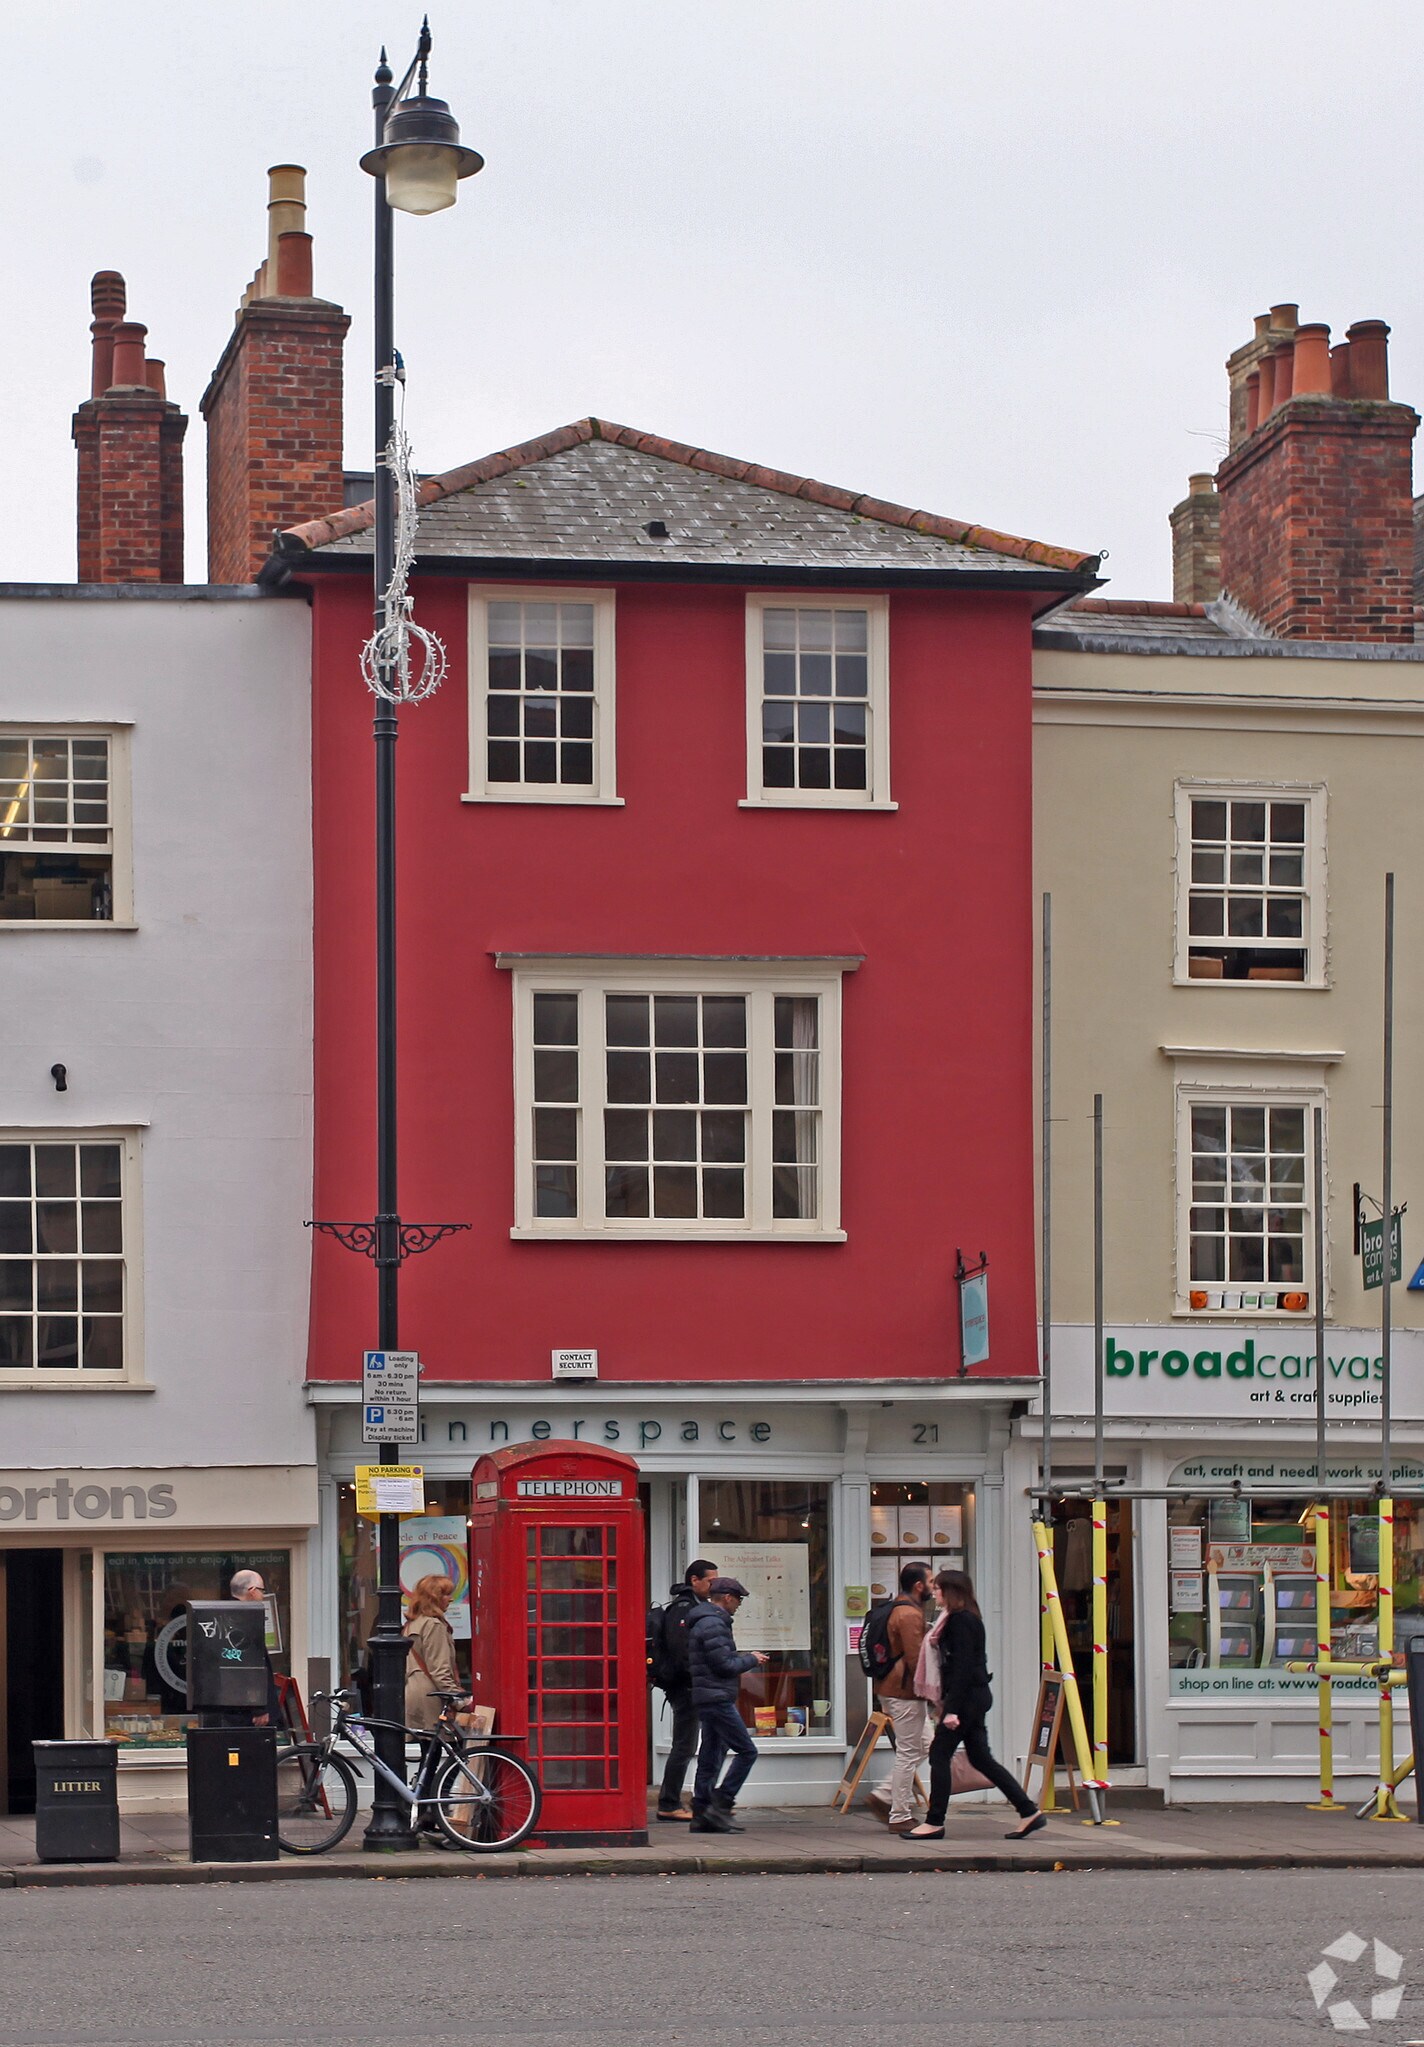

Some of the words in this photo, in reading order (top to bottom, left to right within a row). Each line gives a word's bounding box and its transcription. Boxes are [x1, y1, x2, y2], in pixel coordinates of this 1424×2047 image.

[1363, 1222, 1397, 1253] brod
[1364, 1246, 1398, 1268] cans
[1366, 1272, 1375, 1284] art
[1375, 1269, 1380, 1281] &
[388, 1355, 414, 1363] Loading
[559, 1353, 593, 1361] CONTACT
[558, 1361, 593, 1369] SECURITY
[1249, 1390, 1270, 1403] art
[1274, 1390, 1285, 1403] &
[1290, 1389, 1317, 1403] craf
[421, 1414, 772, 1448] innerspace
[912, 1423, 939, 1444] 21
[1184, 1464, 1206, 1478] art,
[1211, 1464, 1244, 1477] craft
[1247, 1464, 1274, 1477] and
[1280, 1464, 1362, 1478] needlwork
[1367, 1464, 1424, 1481] suplies
[520, 1481, 618, 1495] TELEPHONE
[400, 1532, 414, 1541] cle
[418, 1532, 428, 1541] of
[433, 1532, 458, 1540] Peace
[108, 1555, 125, 1566] eat
[128, 1555, 140, 1567] in,
[144, 1555, 165, 1566] take
[168, 1555, 184, 1565] out
[186, 1557, 197, 1565] or
[200, 1555, 227, 1567] enjoy
[231, 1553, 246, 1564] the
[249, 1553, 285, 1566] garden
[737, 1555, 764, 1563] Alphabet
[1179, 1677, 1209, 1692] shop
[1212, 1679, 1229, 1689] on
[1231, 1677, 1254, 1689] line
[1258, 1677, 1275, 1689] at:
[53, 1781, 101, 1792] LITTER
